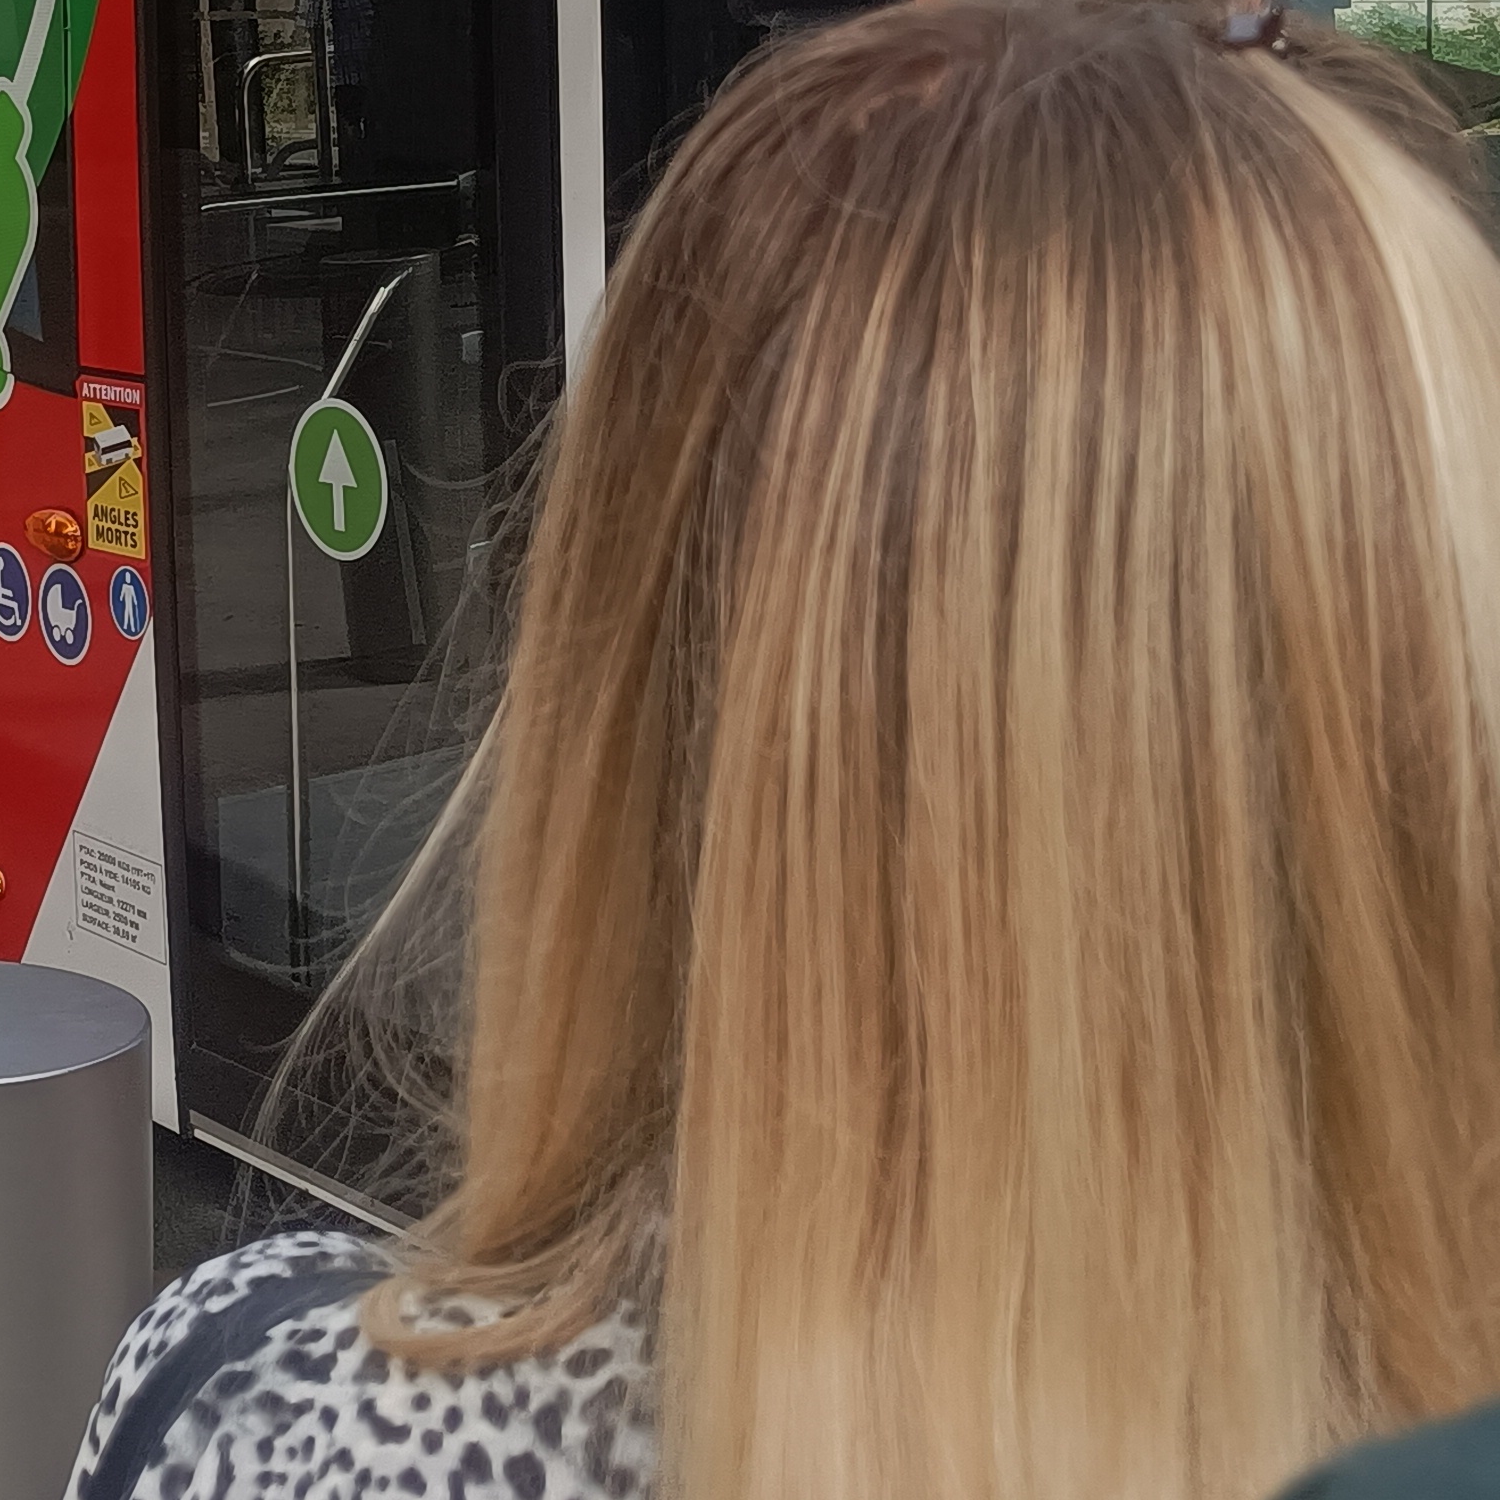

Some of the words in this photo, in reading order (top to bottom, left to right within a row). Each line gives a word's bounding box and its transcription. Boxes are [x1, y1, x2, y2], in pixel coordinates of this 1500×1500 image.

[81, 382, 141, 404] ATTENTION
[92, 503, 139, 529] ANGLES
[95, 522, 138, 549] MORTS
